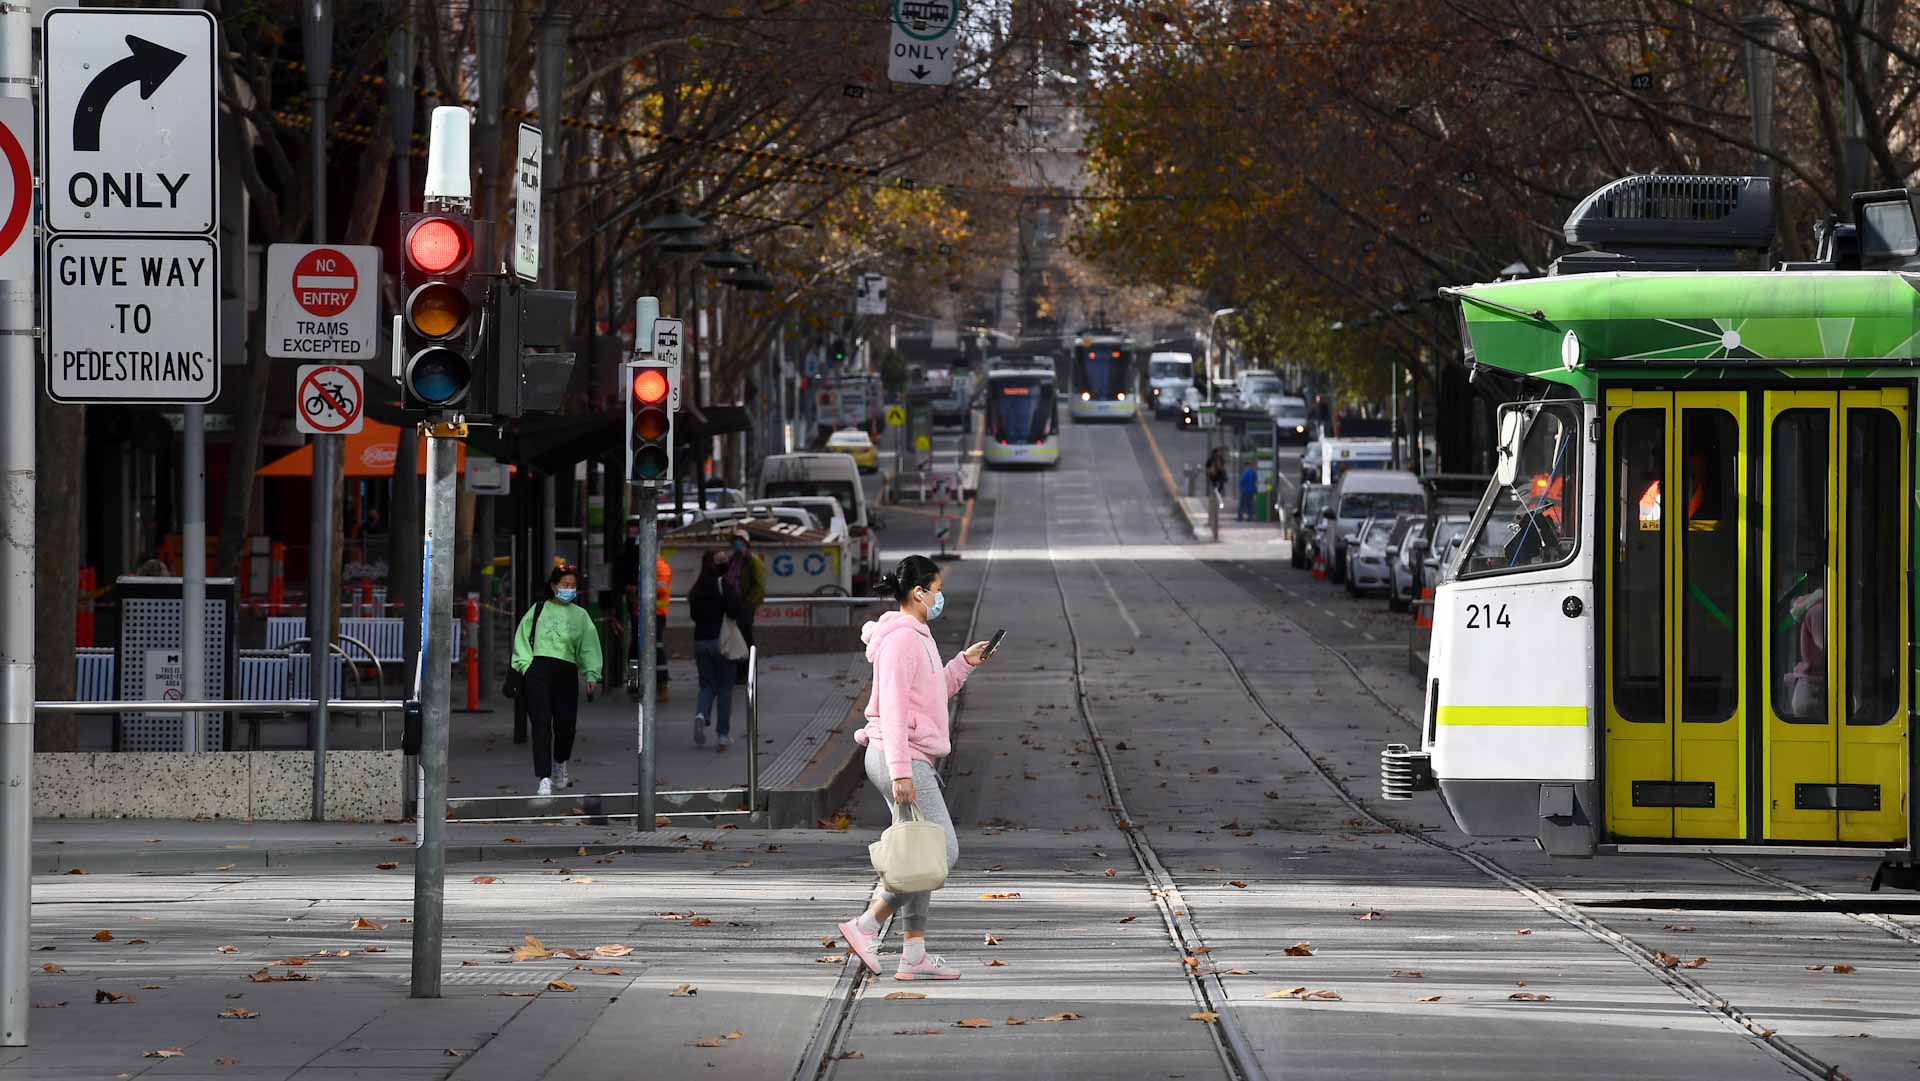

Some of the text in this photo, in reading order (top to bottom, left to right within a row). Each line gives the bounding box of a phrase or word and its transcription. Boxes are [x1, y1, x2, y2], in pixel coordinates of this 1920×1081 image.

[894, 43, 949, 60] ONLY
[68, 172, 190, 209] ONLY
[59, 256, 205, 287] GIVE WAY
[316, 258, 336, 272] NO
[303, 292, 349, 306] ENTRY
[115, 304, 151, 334] TO
[297, 321, 348, 336] TRAMS
[283, 338, 361, 353] EXCEPTED
[63, 351, 204, 382] PEDESTRIANS
[658, 352, 677, 365] WATCH
[1466, 604, 1511, 629] 214
